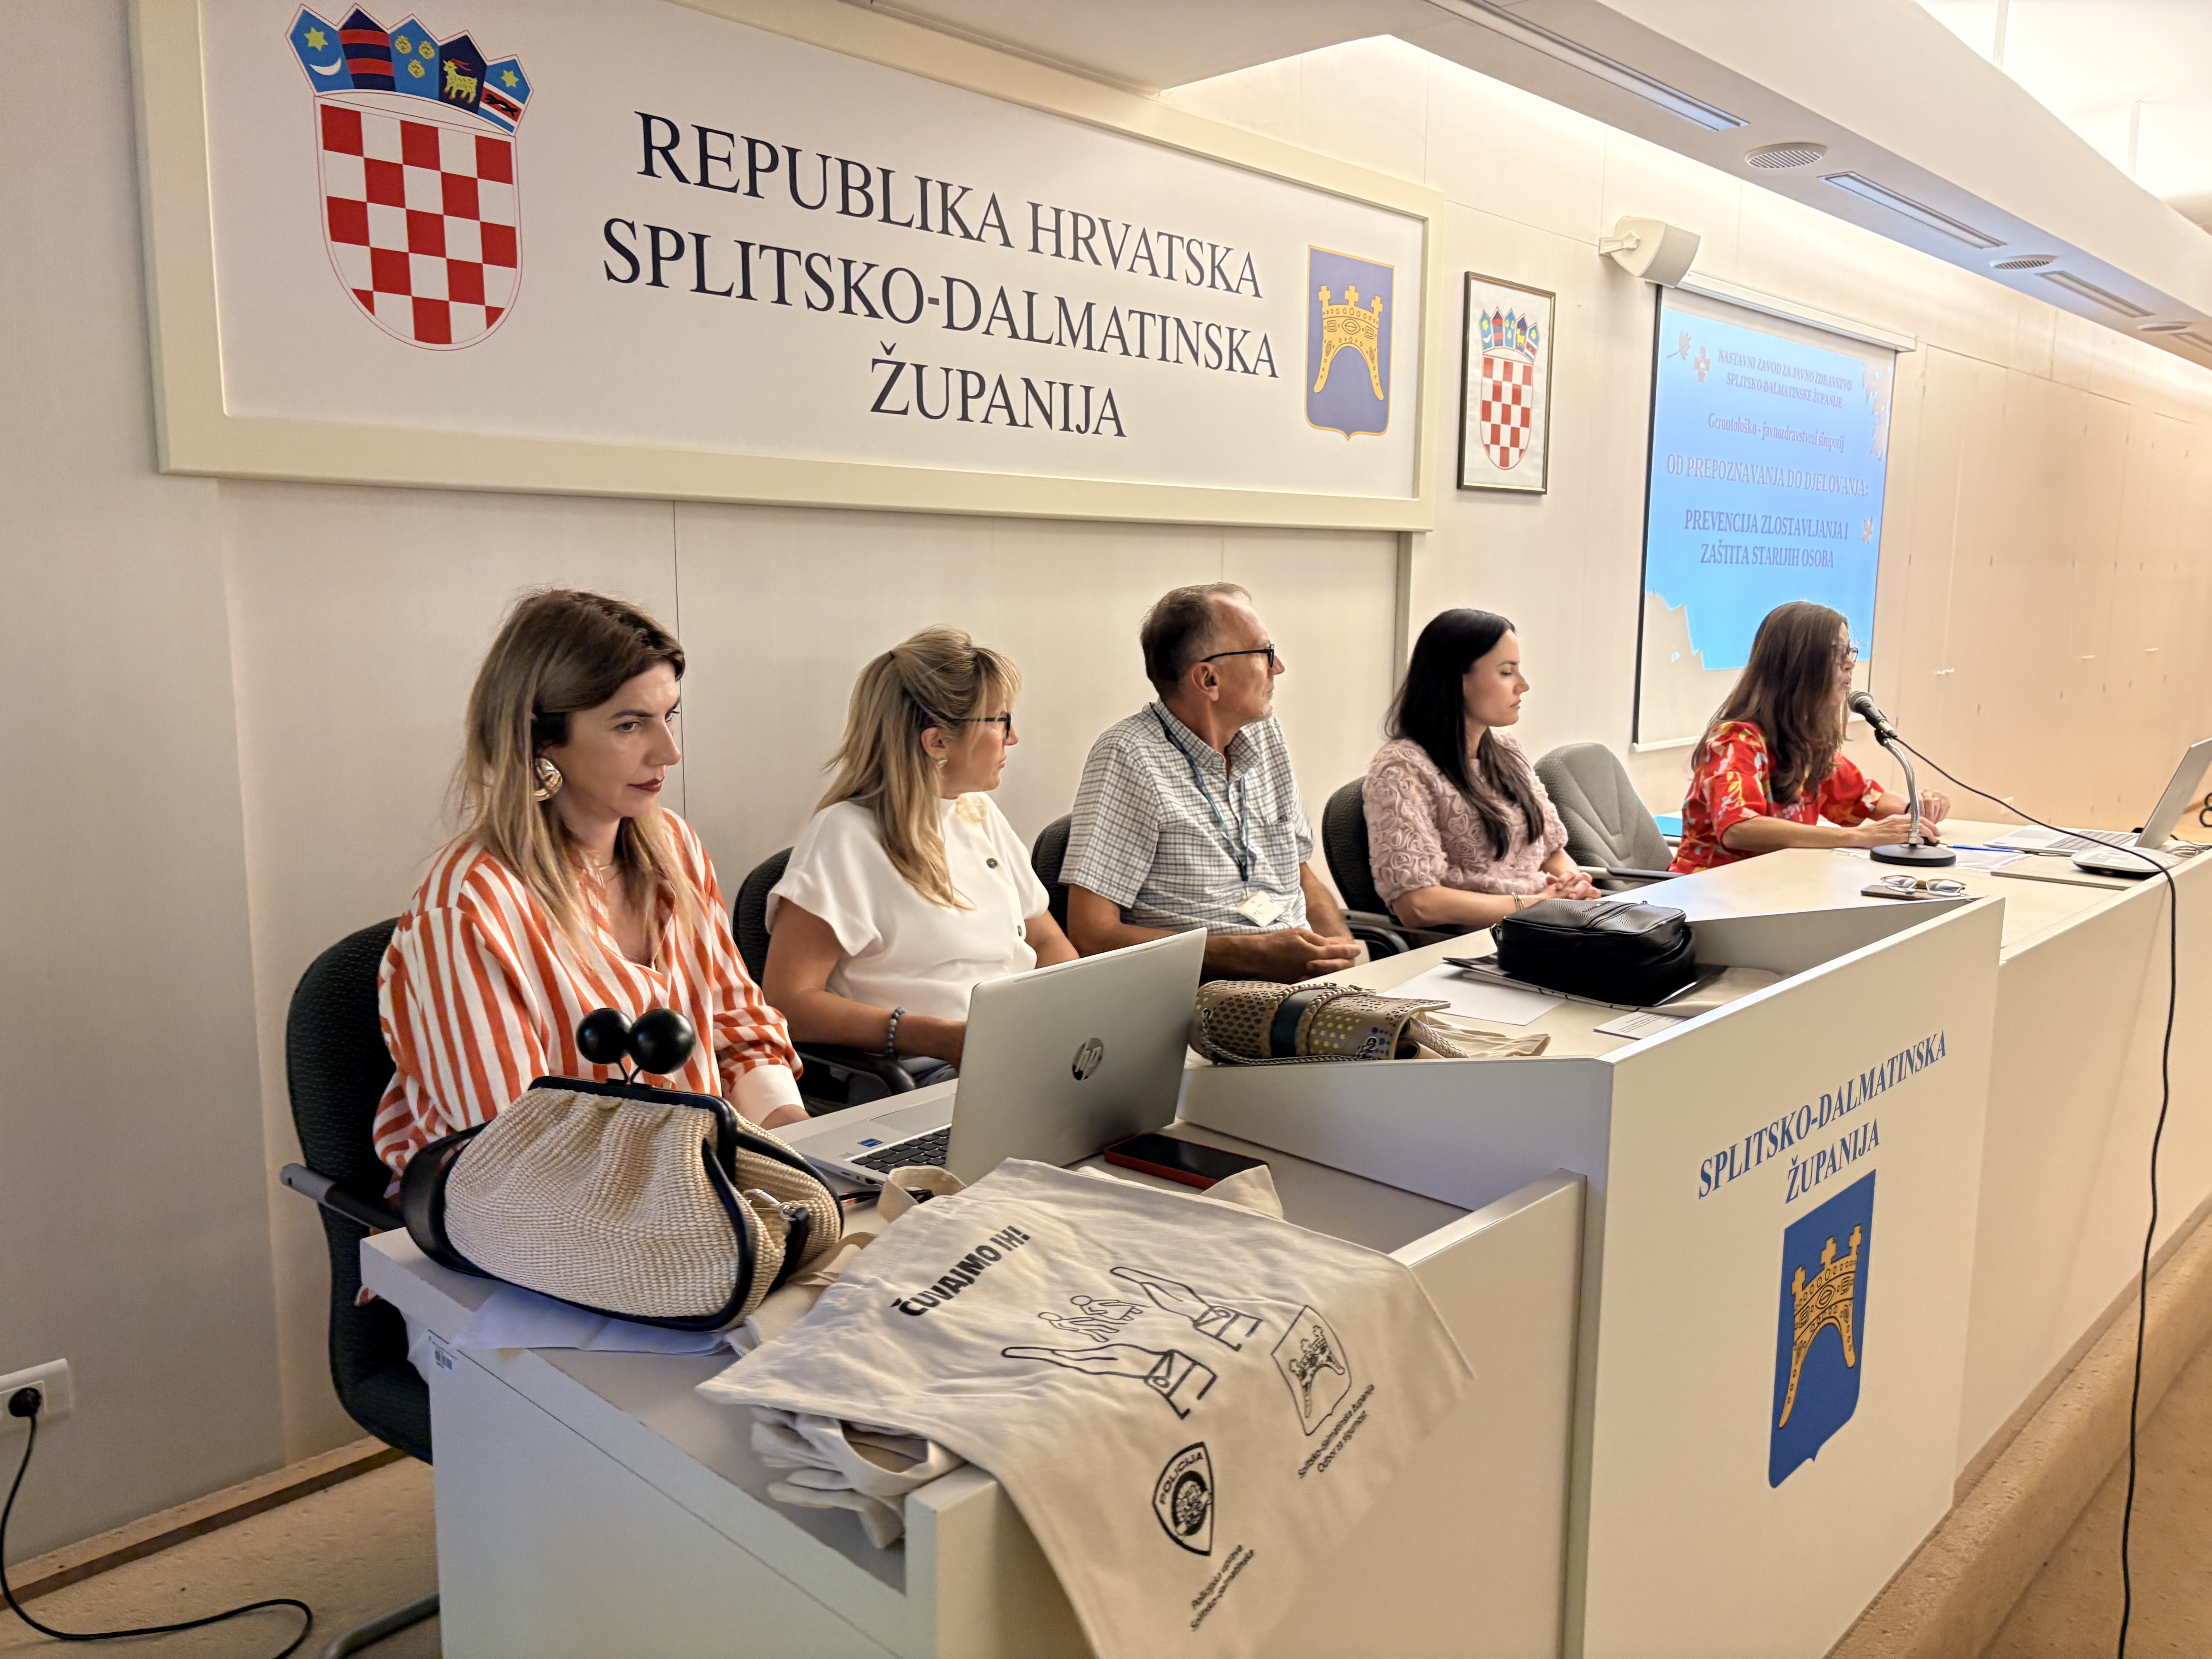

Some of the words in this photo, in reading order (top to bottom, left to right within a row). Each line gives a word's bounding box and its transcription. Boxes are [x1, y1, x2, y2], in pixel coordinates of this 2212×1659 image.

[634, 111, 1015, 249] REPUBLIKA
[1027, 201, 1263, 299] HRVATSKA
[603, 218, 1279, 378] SPLITSKO-DALMATINSKA
[870, 341, 1127, 438] ŽUPANIJA
[1718, 349, 1756, 369] NASTAVNI
[1757, 359, 1781, 374] ZAVOD
[1782, 364, 1791, 378] ZA
[1792, 367, 1814, 383] JAVNO
[1815, 373, 1852, 392] ZDRAVSTVO
[1726, 373, 1812, 402] SPLITSKO-DALMATINSKE
[1813, 388, 1843, 408] ŽUPANIJE
[1708, 412, 1757, 435] Gerontološko
[1762, 422, 1818, 446] javnozdravstveni
[1818, 432, 1844, 453] simpozij
[1667, 454, 1684, 476] OD
[1686, 457, 1784, 488] PREPOZNAVANJA
[1786, 469, 1803, 489] DO
[1804, 472, 1869, 497] DJELOVANJA:
[1684, 509, 1759, 534] PREVENCIJA
[1760, 515, 1843, 540] ZLOSTAVLJANJA
[1844, 522, 1849, 540] I
[1700, 539, 1750, 565] ZAŠTITA
[1752, 546, 1800, 567] STARIJIH
[1802, 548, 1834, 568] OSOBA
[1698, 1030, 1946, 1200] SPLITSKO-DALMATINSKA
[1785, 1118, 1880, 1204] ŽUPANIJA
[890, 1245, 1002, 1316] ČUVAJMO
[989, 1225, 1030, 1251] IH!
[1159, 1452, 1204, 1505] POLICIJA
